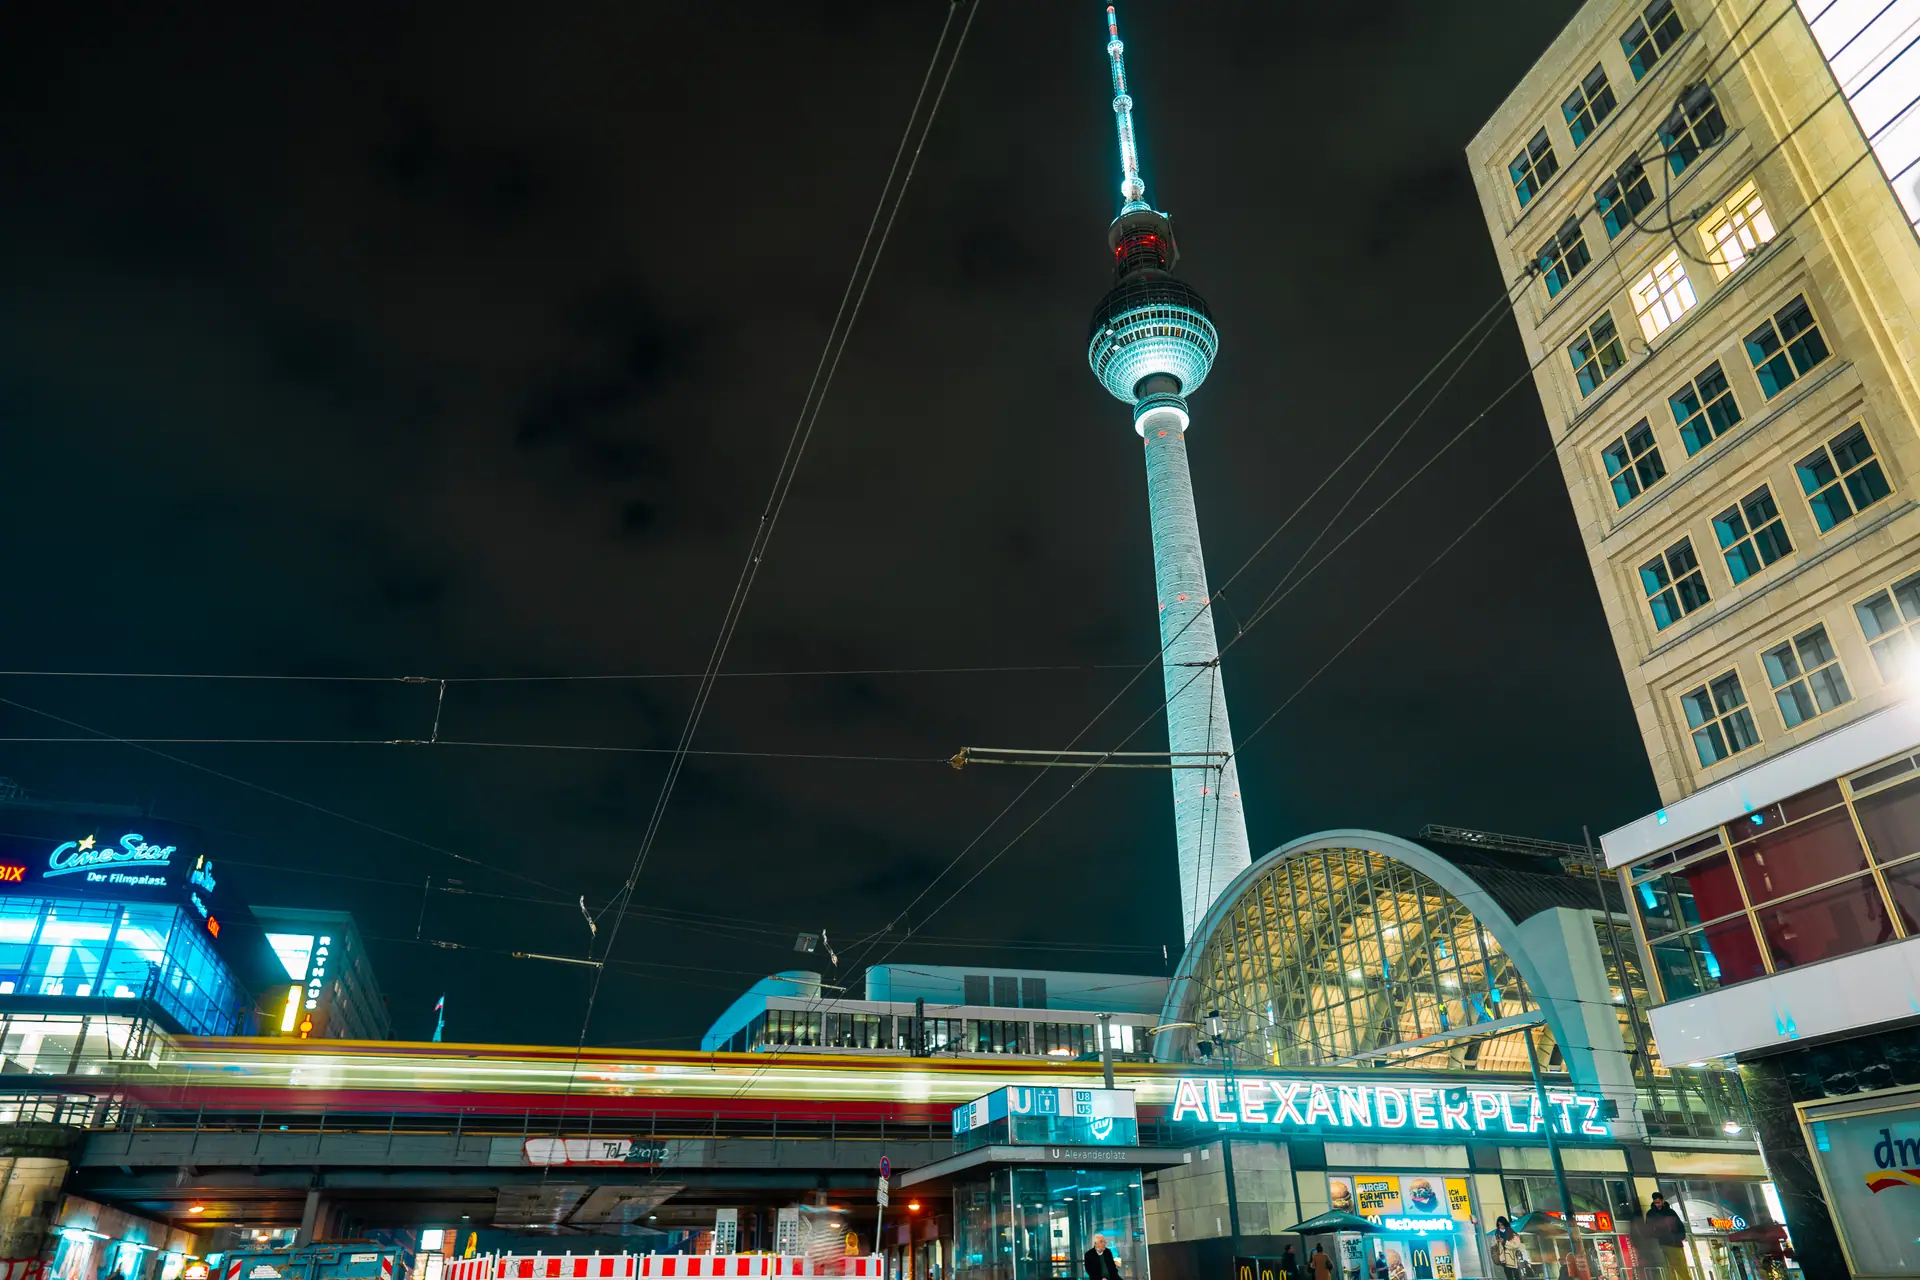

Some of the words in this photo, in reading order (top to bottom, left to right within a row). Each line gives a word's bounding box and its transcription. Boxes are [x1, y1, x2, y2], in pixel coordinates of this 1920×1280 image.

[49, 833, 177, 870] CineStar
[87, 872, 107, 883] Der
[305, 936, 331, 1010] RATHAUS
[1014, 1088, 1031, 1114] U
[1077, 1091, 1091, 1101] U8
[1078, 1104, 1091, 1114] U5
[1173, 1077, 1608, 1136] ALEXANDERPLATZ
[1052, 1148, 1060, 1159] U
[1064, 1149, 1126, 1160] Alexanderplatz
[1874, 1128, 1920, 1169] dm
[1358, 1182, 1389, 1192] BURGER
[1360, 1192, 1374, 1201] FÜR
[1374, 1191, 1399, 1200] MITTE?
[1450, 1195, 1467, 1203] LIEBE
[1361, 1200, 1384, 1209] BITTE!
[1437, 1264, 1454, 1275] FÜR
